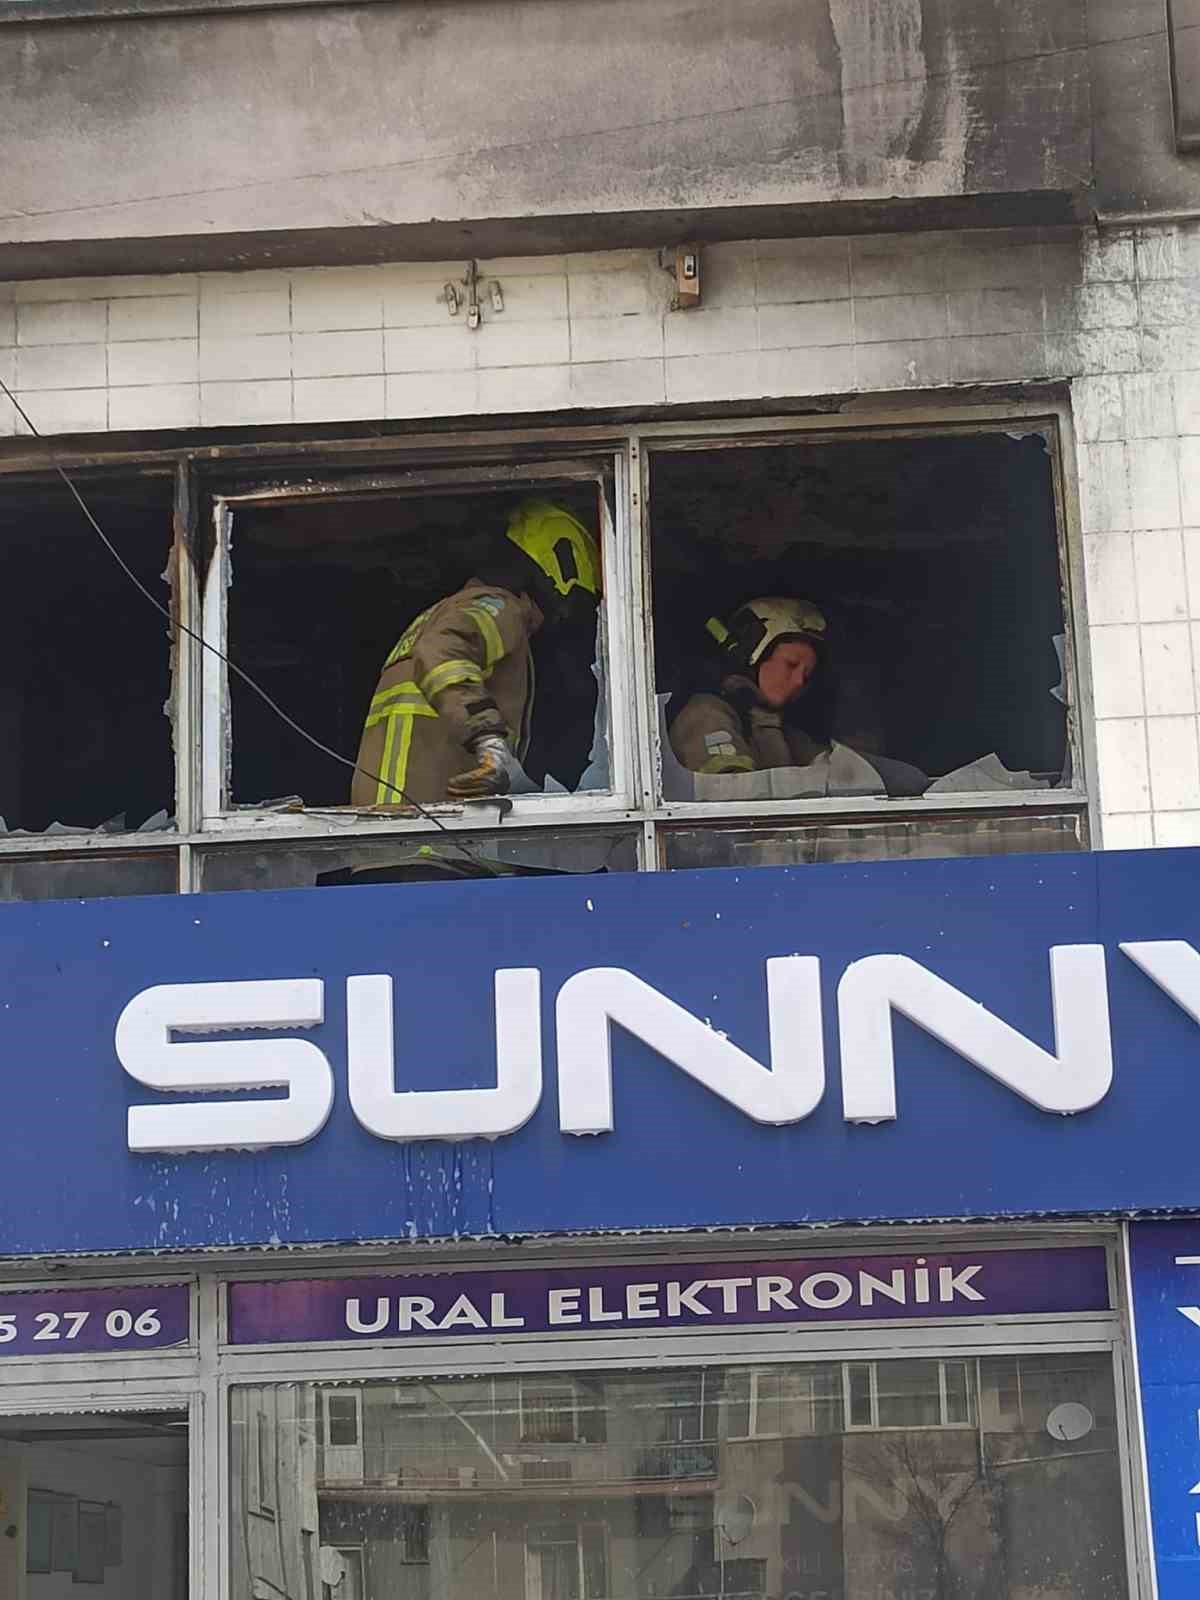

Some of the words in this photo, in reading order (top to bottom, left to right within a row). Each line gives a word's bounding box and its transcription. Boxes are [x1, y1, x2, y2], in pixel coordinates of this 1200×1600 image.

[345, 1293, 525, 1334] URAL
[548, 1257, 987, 1325] ELEKTRONİK
[33, 1311, 90, 1341] 27
[105, 1308, 162, 1338] 06
